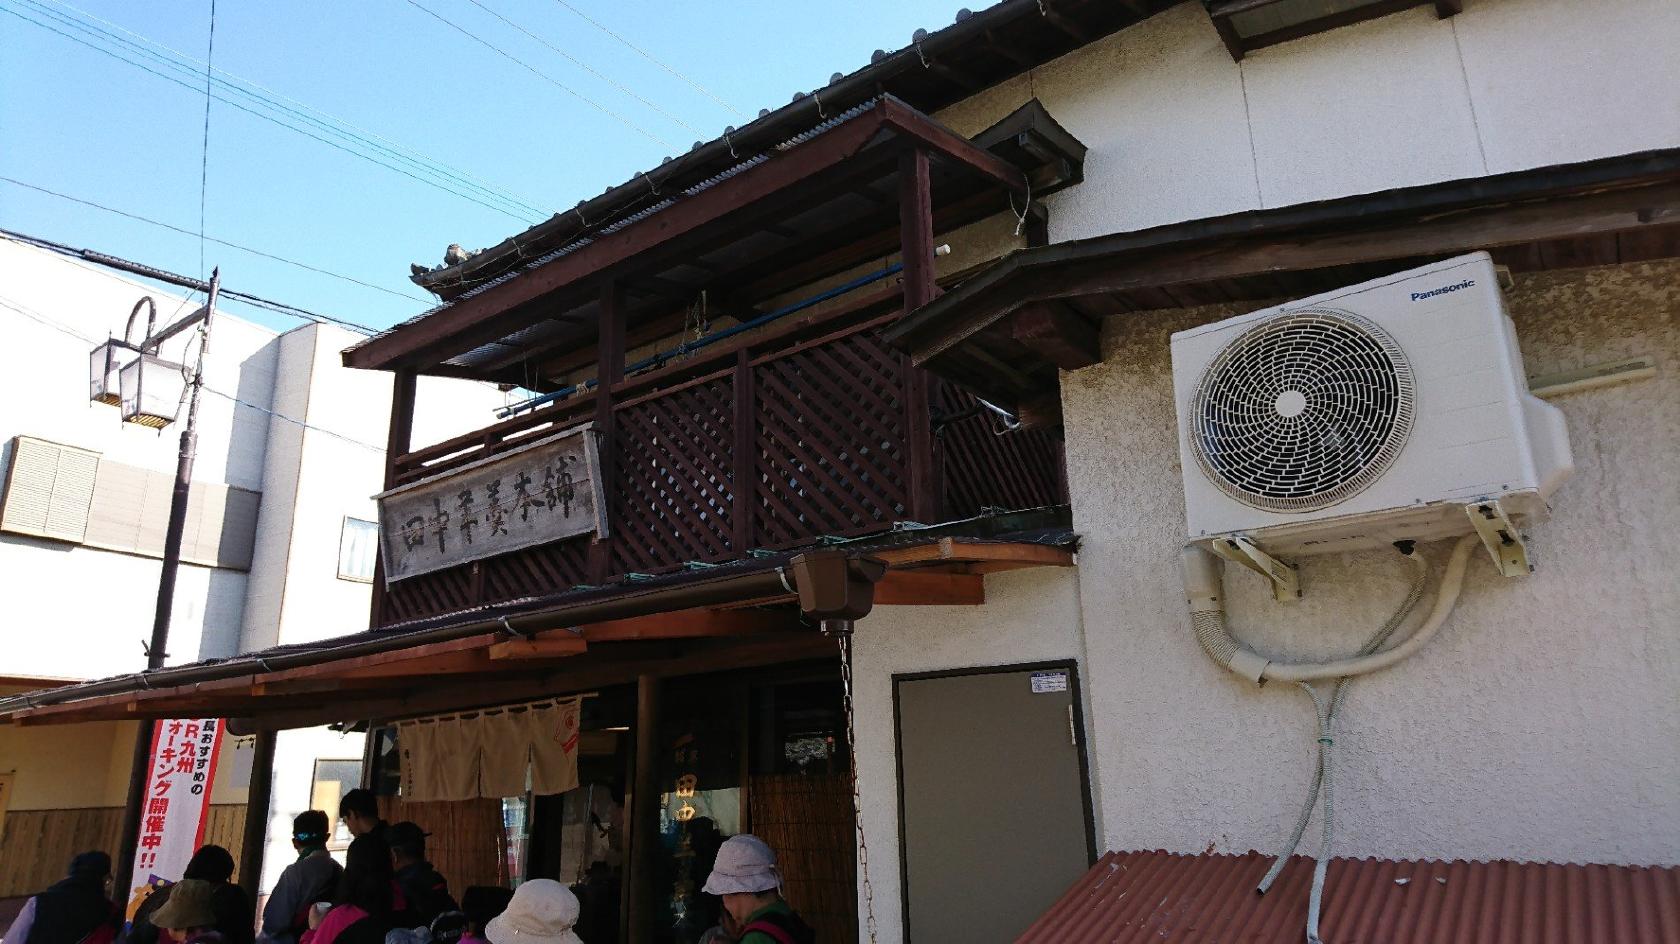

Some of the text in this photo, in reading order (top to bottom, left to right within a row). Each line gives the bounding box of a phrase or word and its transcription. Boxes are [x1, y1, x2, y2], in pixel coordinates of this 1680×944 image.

[1411, 280, 1475, 301] Panasonic
[176, 718, 199, 774] R九州
[190, 718, 217, 795] 長おすすめの
[139, 718, 183, 869] オーキング開催中!!
